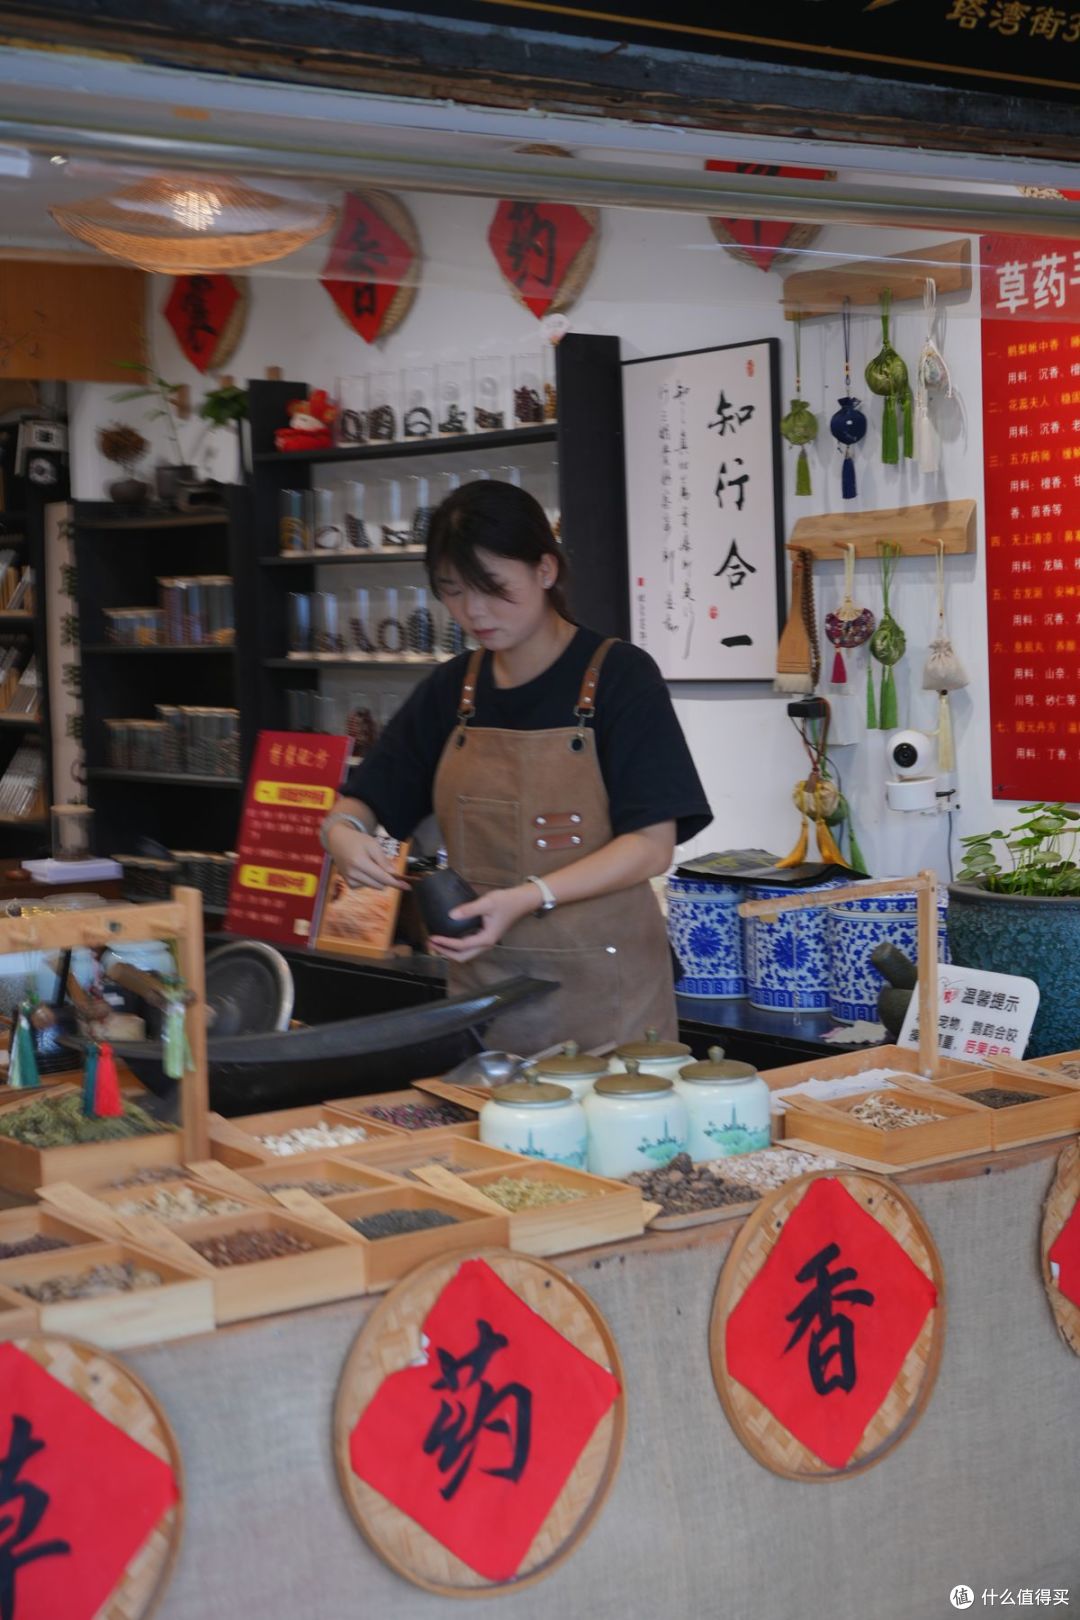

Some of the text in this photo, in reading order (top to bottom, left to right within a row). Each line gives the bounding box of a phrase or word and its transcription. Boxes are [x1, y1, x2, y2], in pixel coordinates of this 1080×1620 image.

[707, 389, 757, 648] 知行合一
[961, 986, 1020, 1013] 温馨提示
[784, 1242, 875, 1396] 香
[423, 1318, 533, 1502] 药
